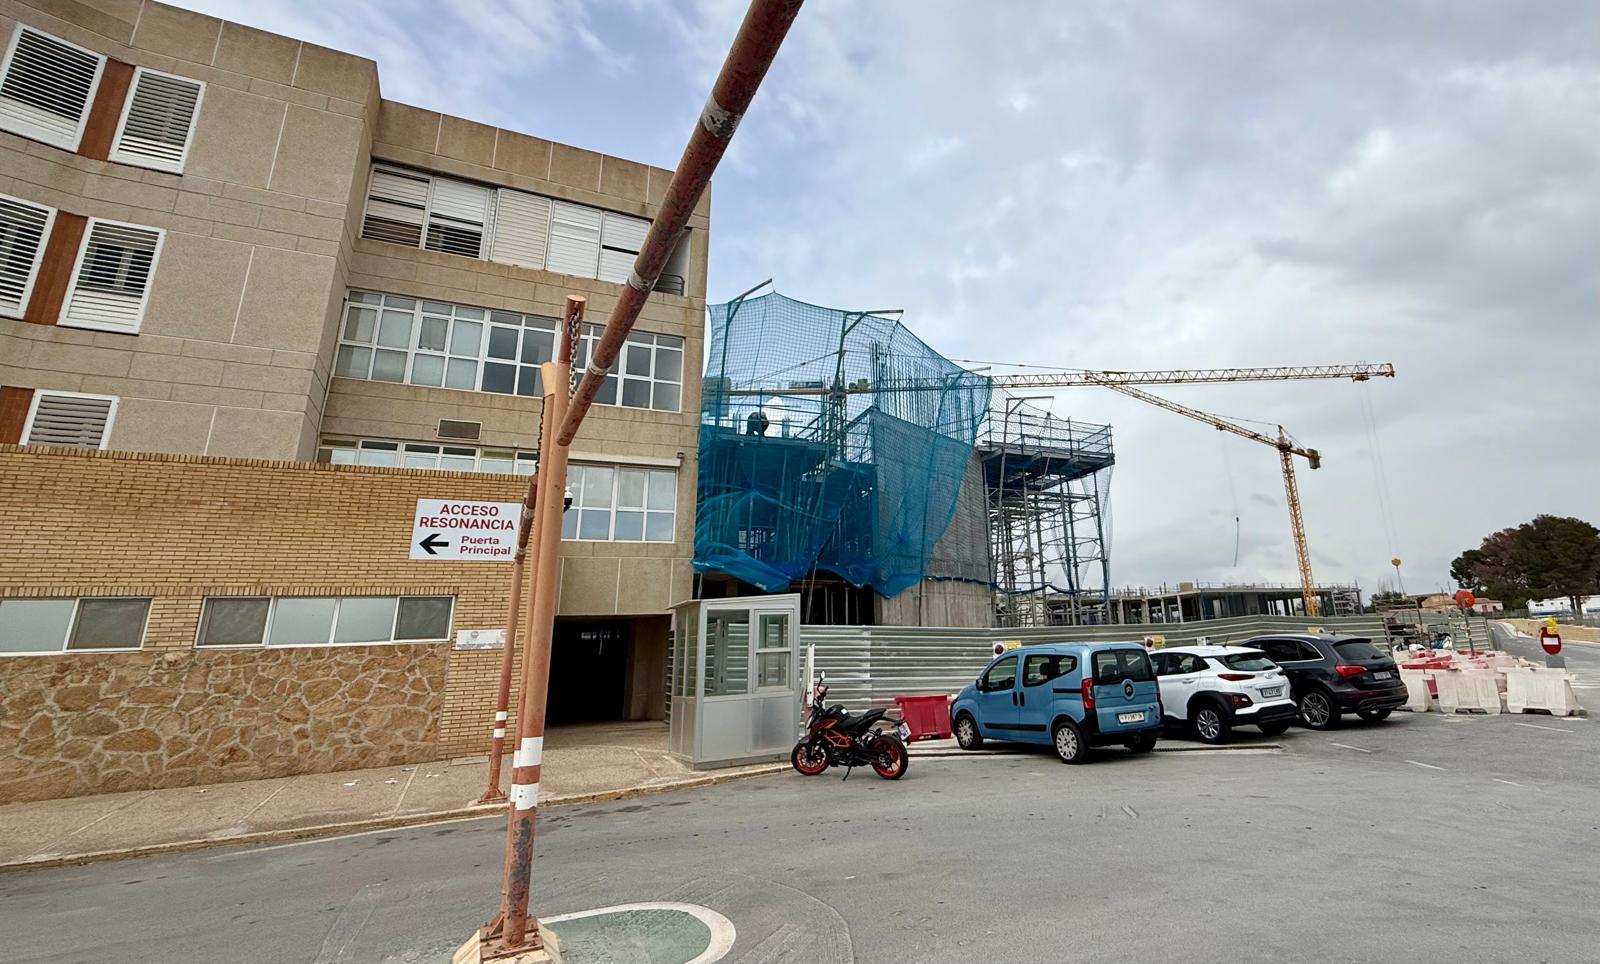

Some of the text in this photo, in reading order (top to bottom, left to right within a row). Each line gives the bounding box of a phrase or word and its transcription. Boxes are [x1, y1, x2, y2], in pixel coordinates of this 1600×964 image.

[439, 504, 499, 516] ACCESO
[419, 516, 514, 530] RESONANCIA
[461, 535, 499, 545] Puerta
[460, 546, 511, 556] Principal
